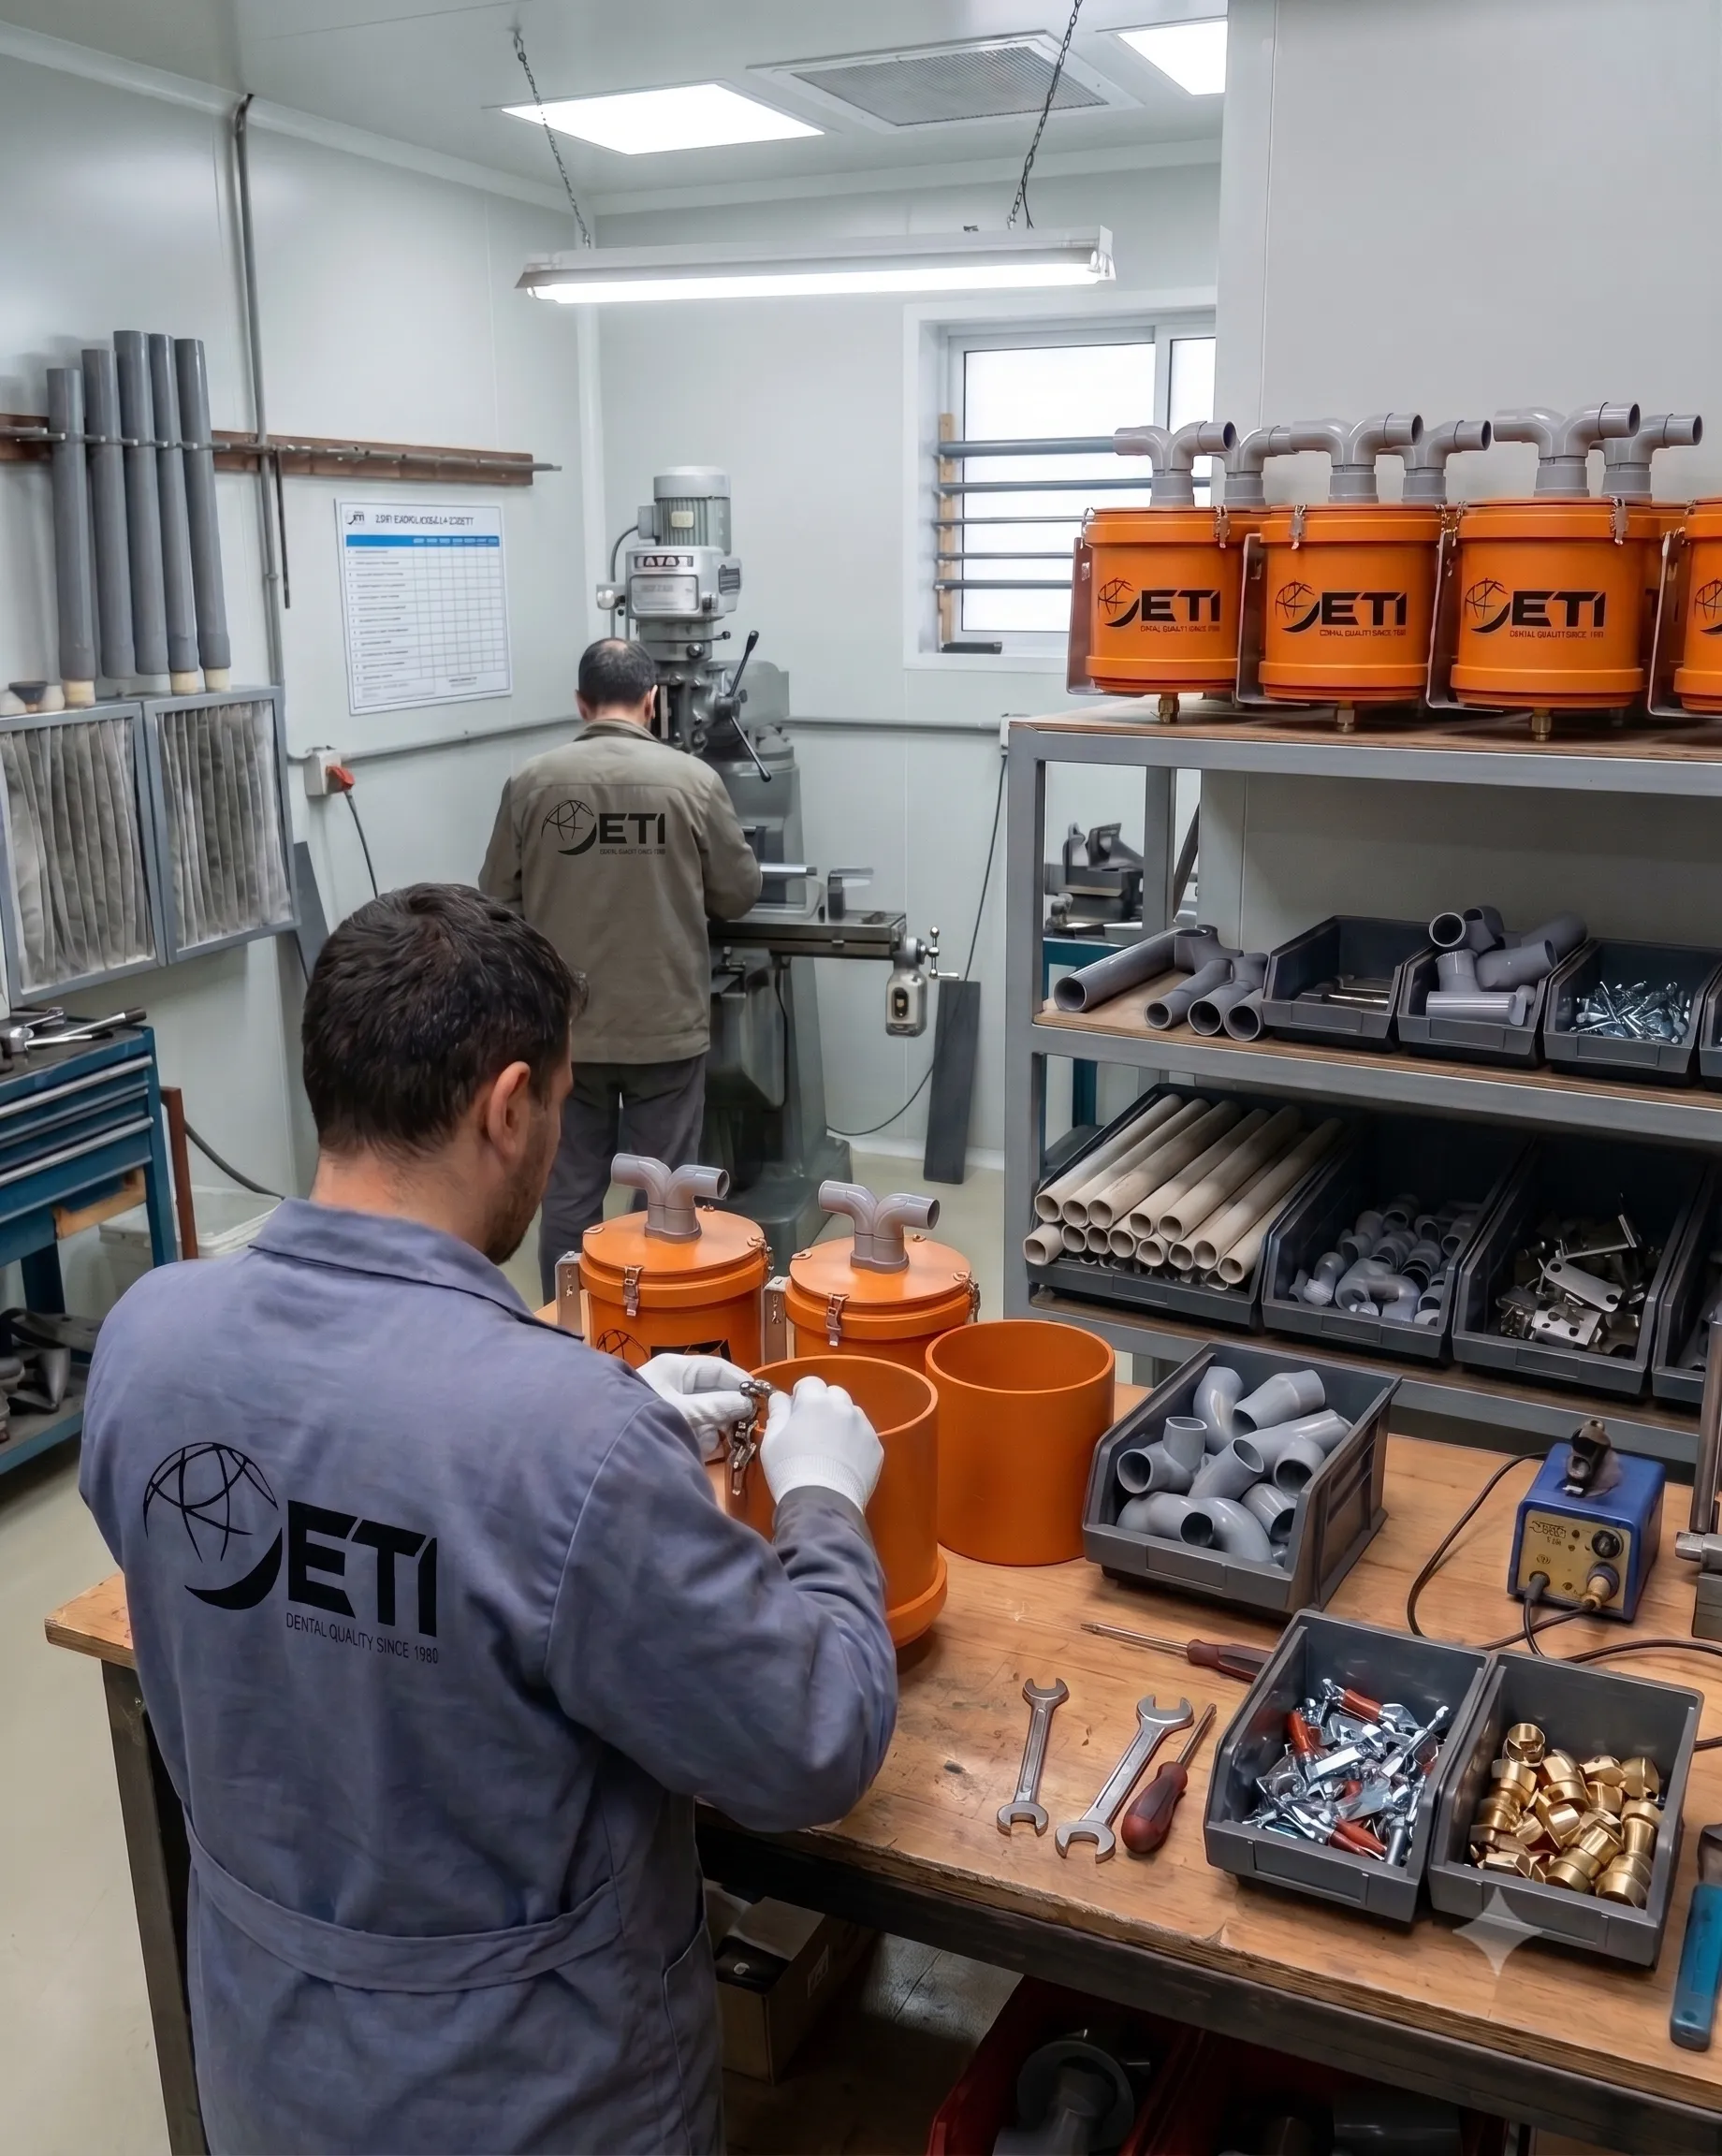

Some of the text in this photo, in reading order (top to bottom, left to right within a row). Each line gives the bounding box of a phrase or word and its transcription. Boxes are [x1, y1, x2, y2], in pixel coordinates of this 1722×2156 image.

[285, 1612, 439, 1665] DENTAL QUALITY SINCE 1980
